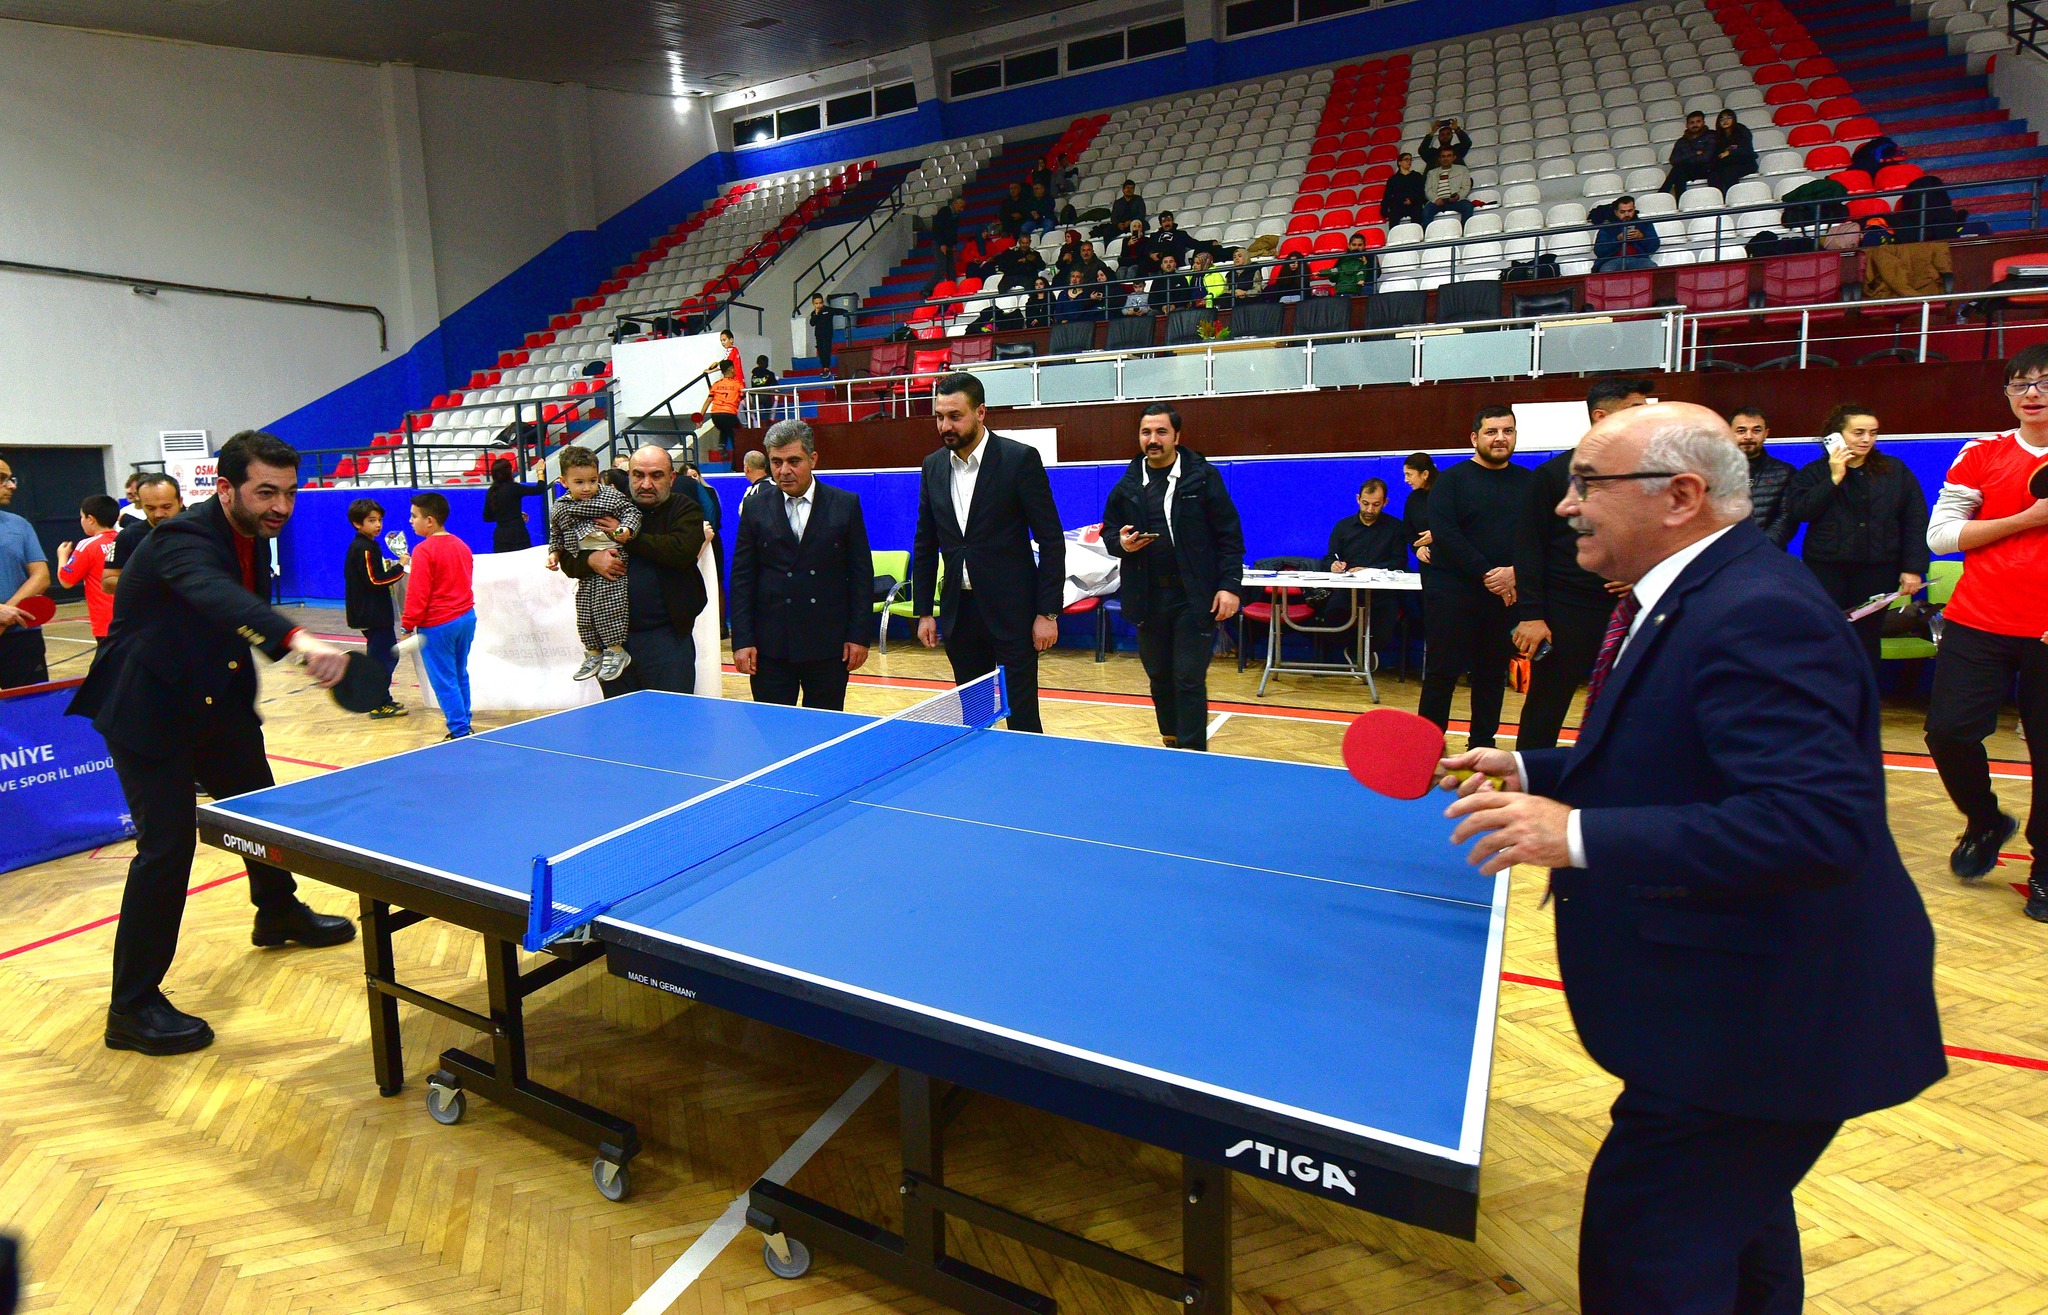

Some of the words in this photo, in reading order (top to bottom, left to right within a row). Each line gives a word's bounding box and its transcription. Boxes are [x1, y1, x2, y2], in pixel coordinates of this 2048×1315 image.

[0, 744, 55, 770] NİYE
[0, 779, 17, 792] VE
[20, 771, 57, 788] SPOR
[58, 767, 71, 779] İL
[73, 756, 114, 776] MÜDÜ
[223, 833, 267, 859] OPTIMUM
[628, 971, 649, 985] MADE
[650, 978, 658, 988] IN
[659, 981, 697, 999] GERMANY
[1225, 1139, 1356, 1197] STIGA
